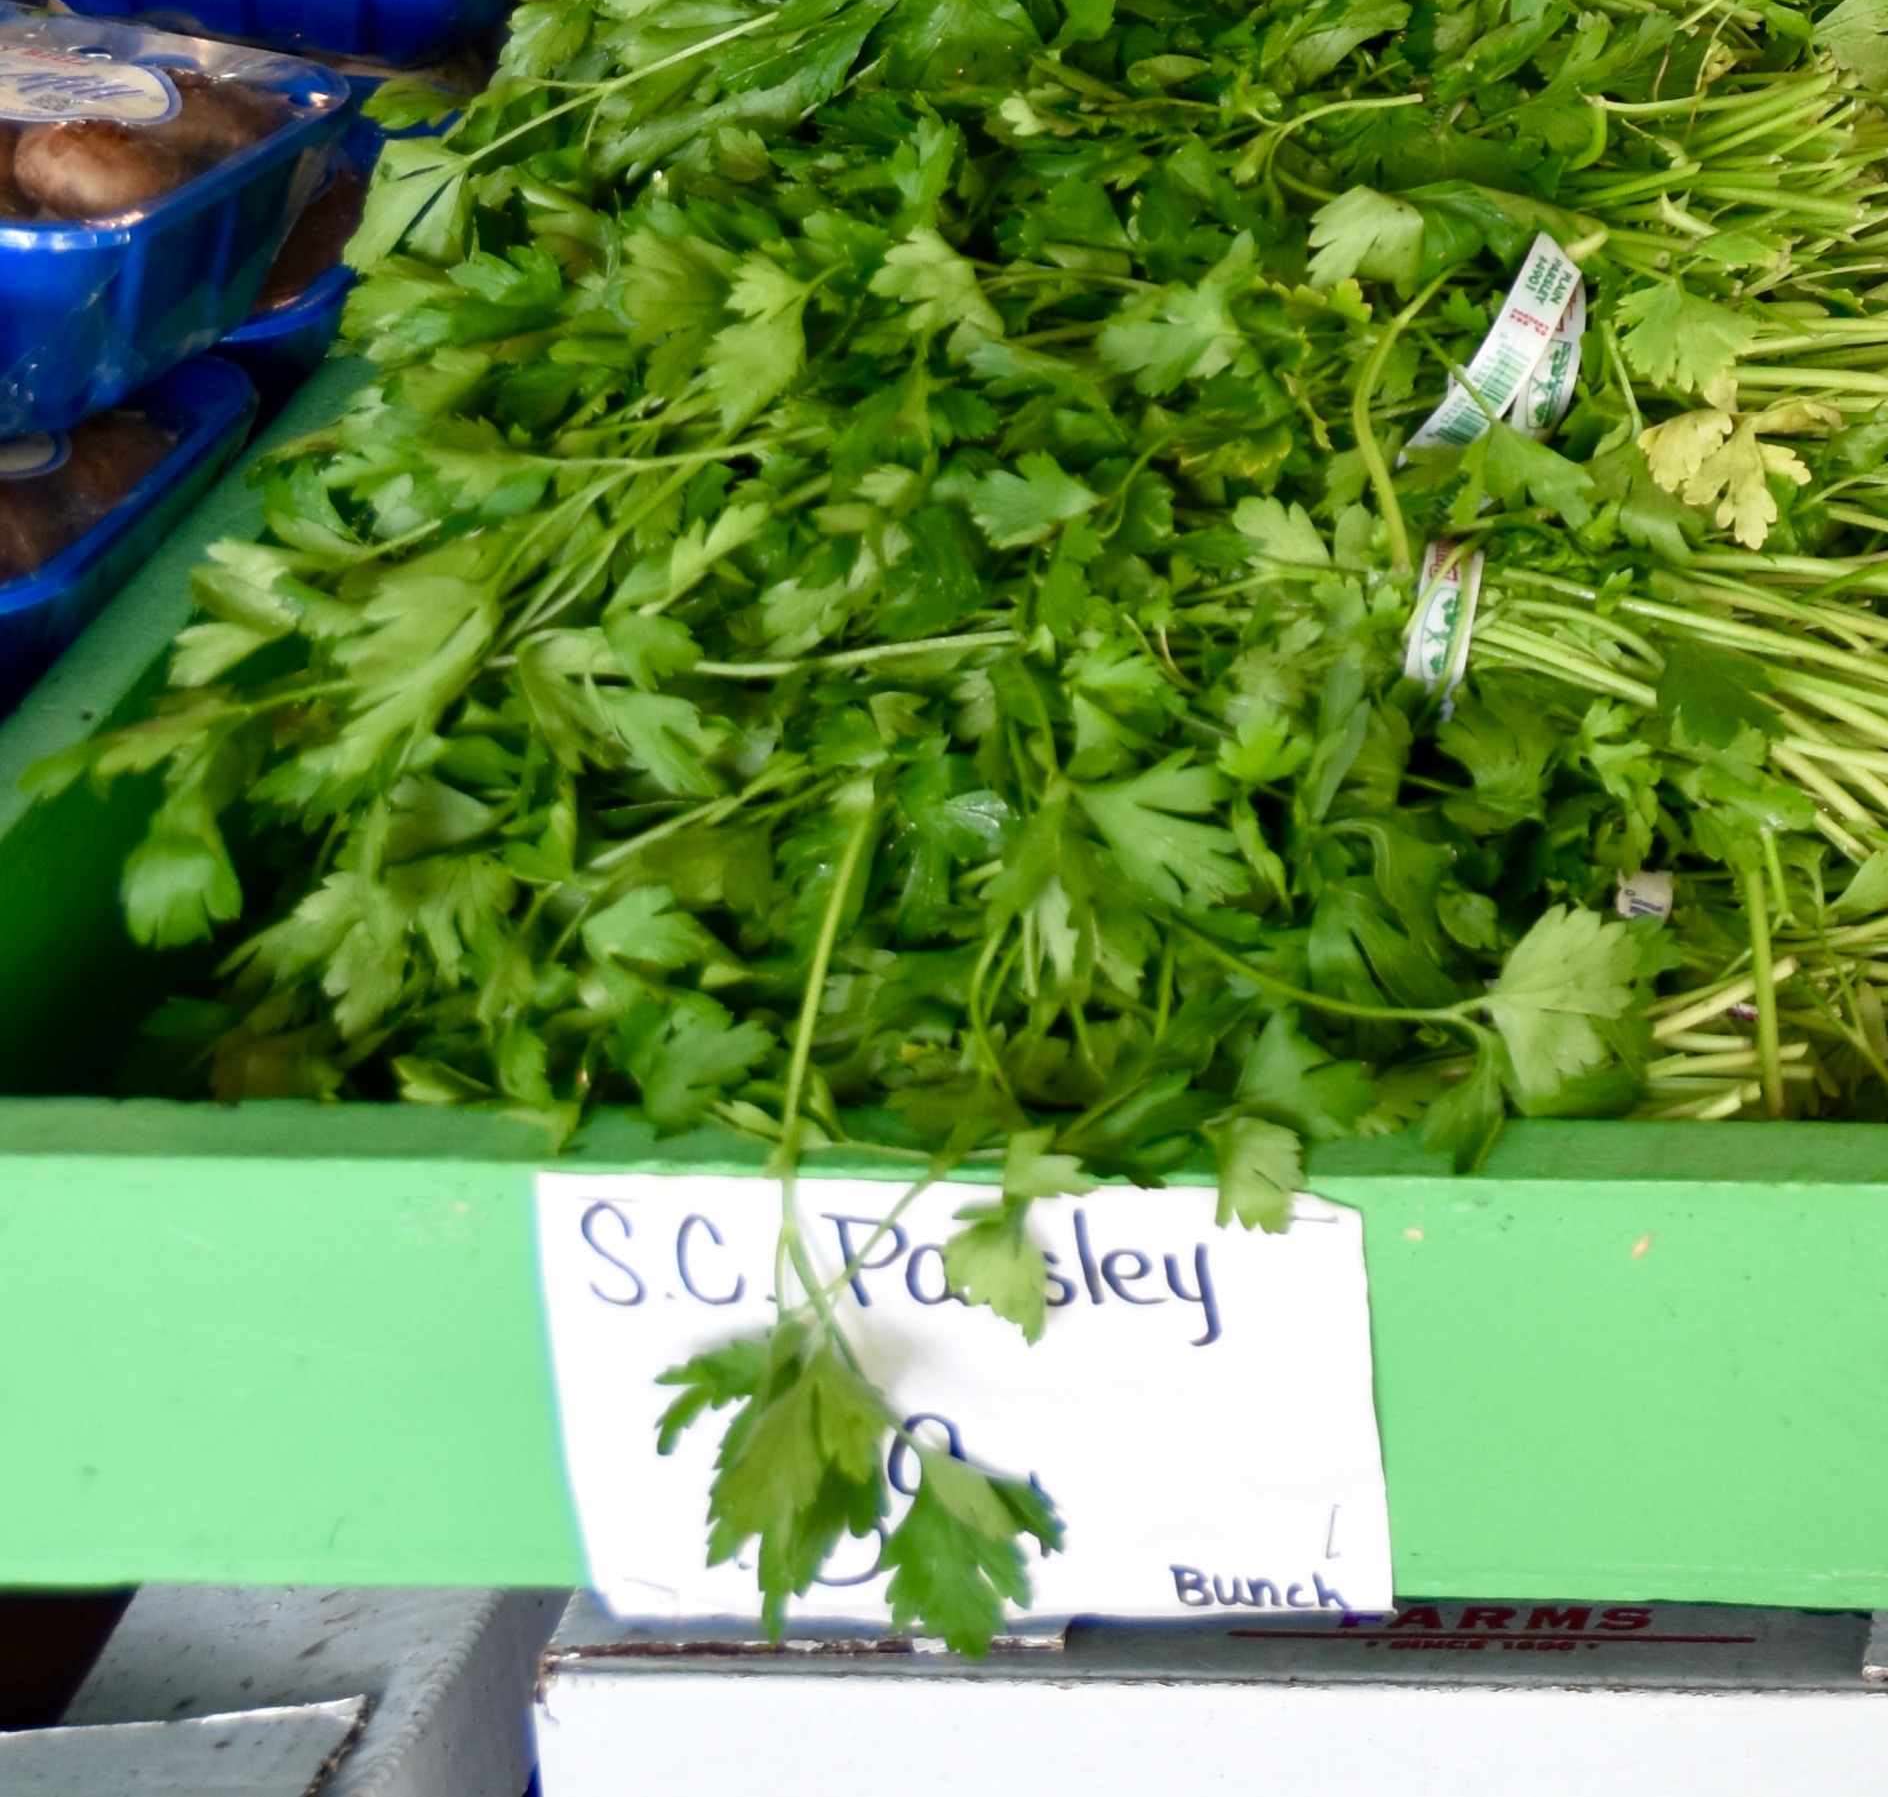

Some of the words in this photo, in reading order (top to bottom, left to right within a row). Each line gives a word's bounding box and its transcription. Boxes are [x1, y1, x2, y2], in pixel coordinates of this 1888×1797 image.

[1550, 270, 1574, 305] PLAIN
[821, 1207, 1224, 1349] Pasley
[1171, 1564, 1349, 1612] Bunch
